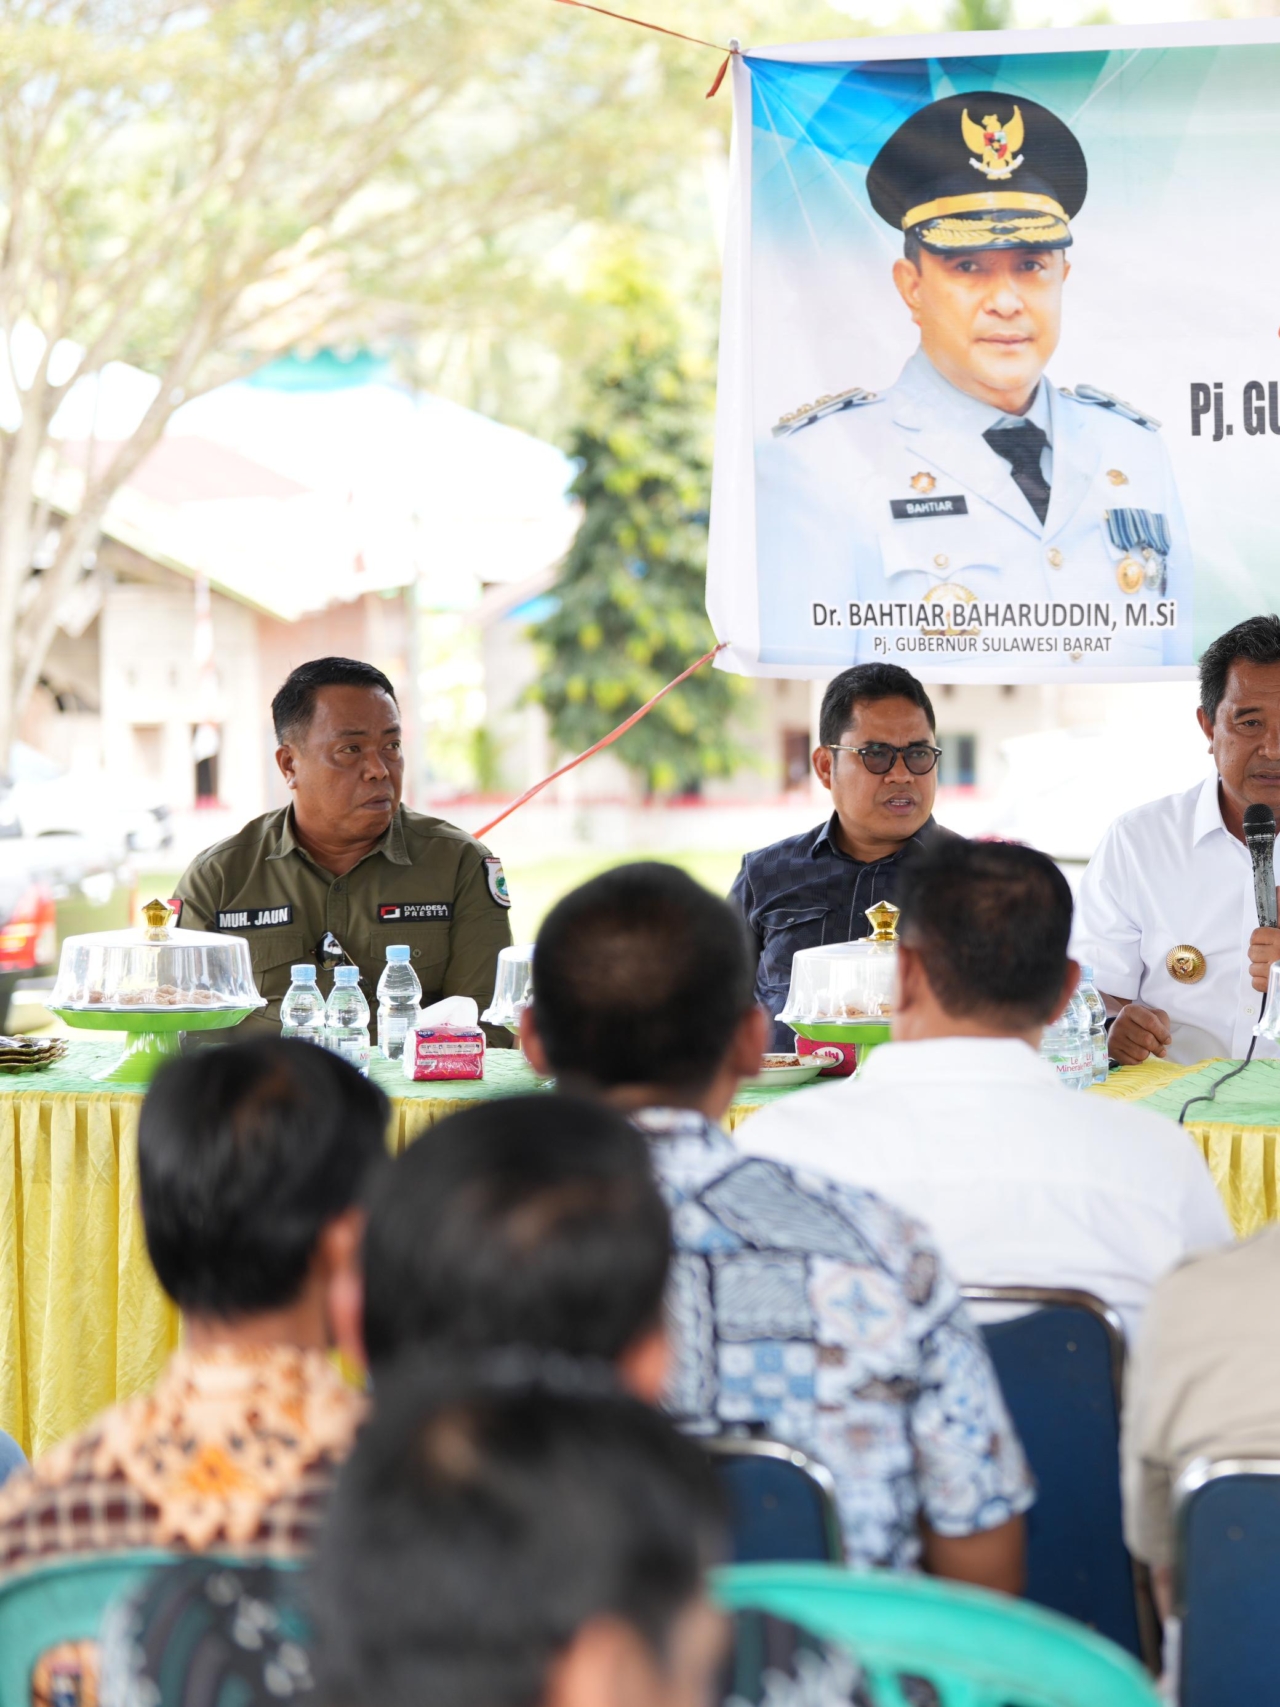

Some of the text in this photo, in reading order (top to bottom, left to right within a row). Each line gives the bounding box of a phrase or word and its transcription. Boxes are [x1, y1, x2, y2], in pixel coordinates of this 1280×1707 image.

[1189, 381, 1234, 442] Pj.
[905, 500, 954, 515] BAHTIAR
[812, 601, 1176, 632] Dr. BAHTIAR BAHARUDDIN, M.Si
[873, 636, 1113, 656] Pj. GUBERNUR SULAWESI BARAT
[218, 906, 289, 928] MUH. JAUN
[403, 910, 449, 918] PRESISI
